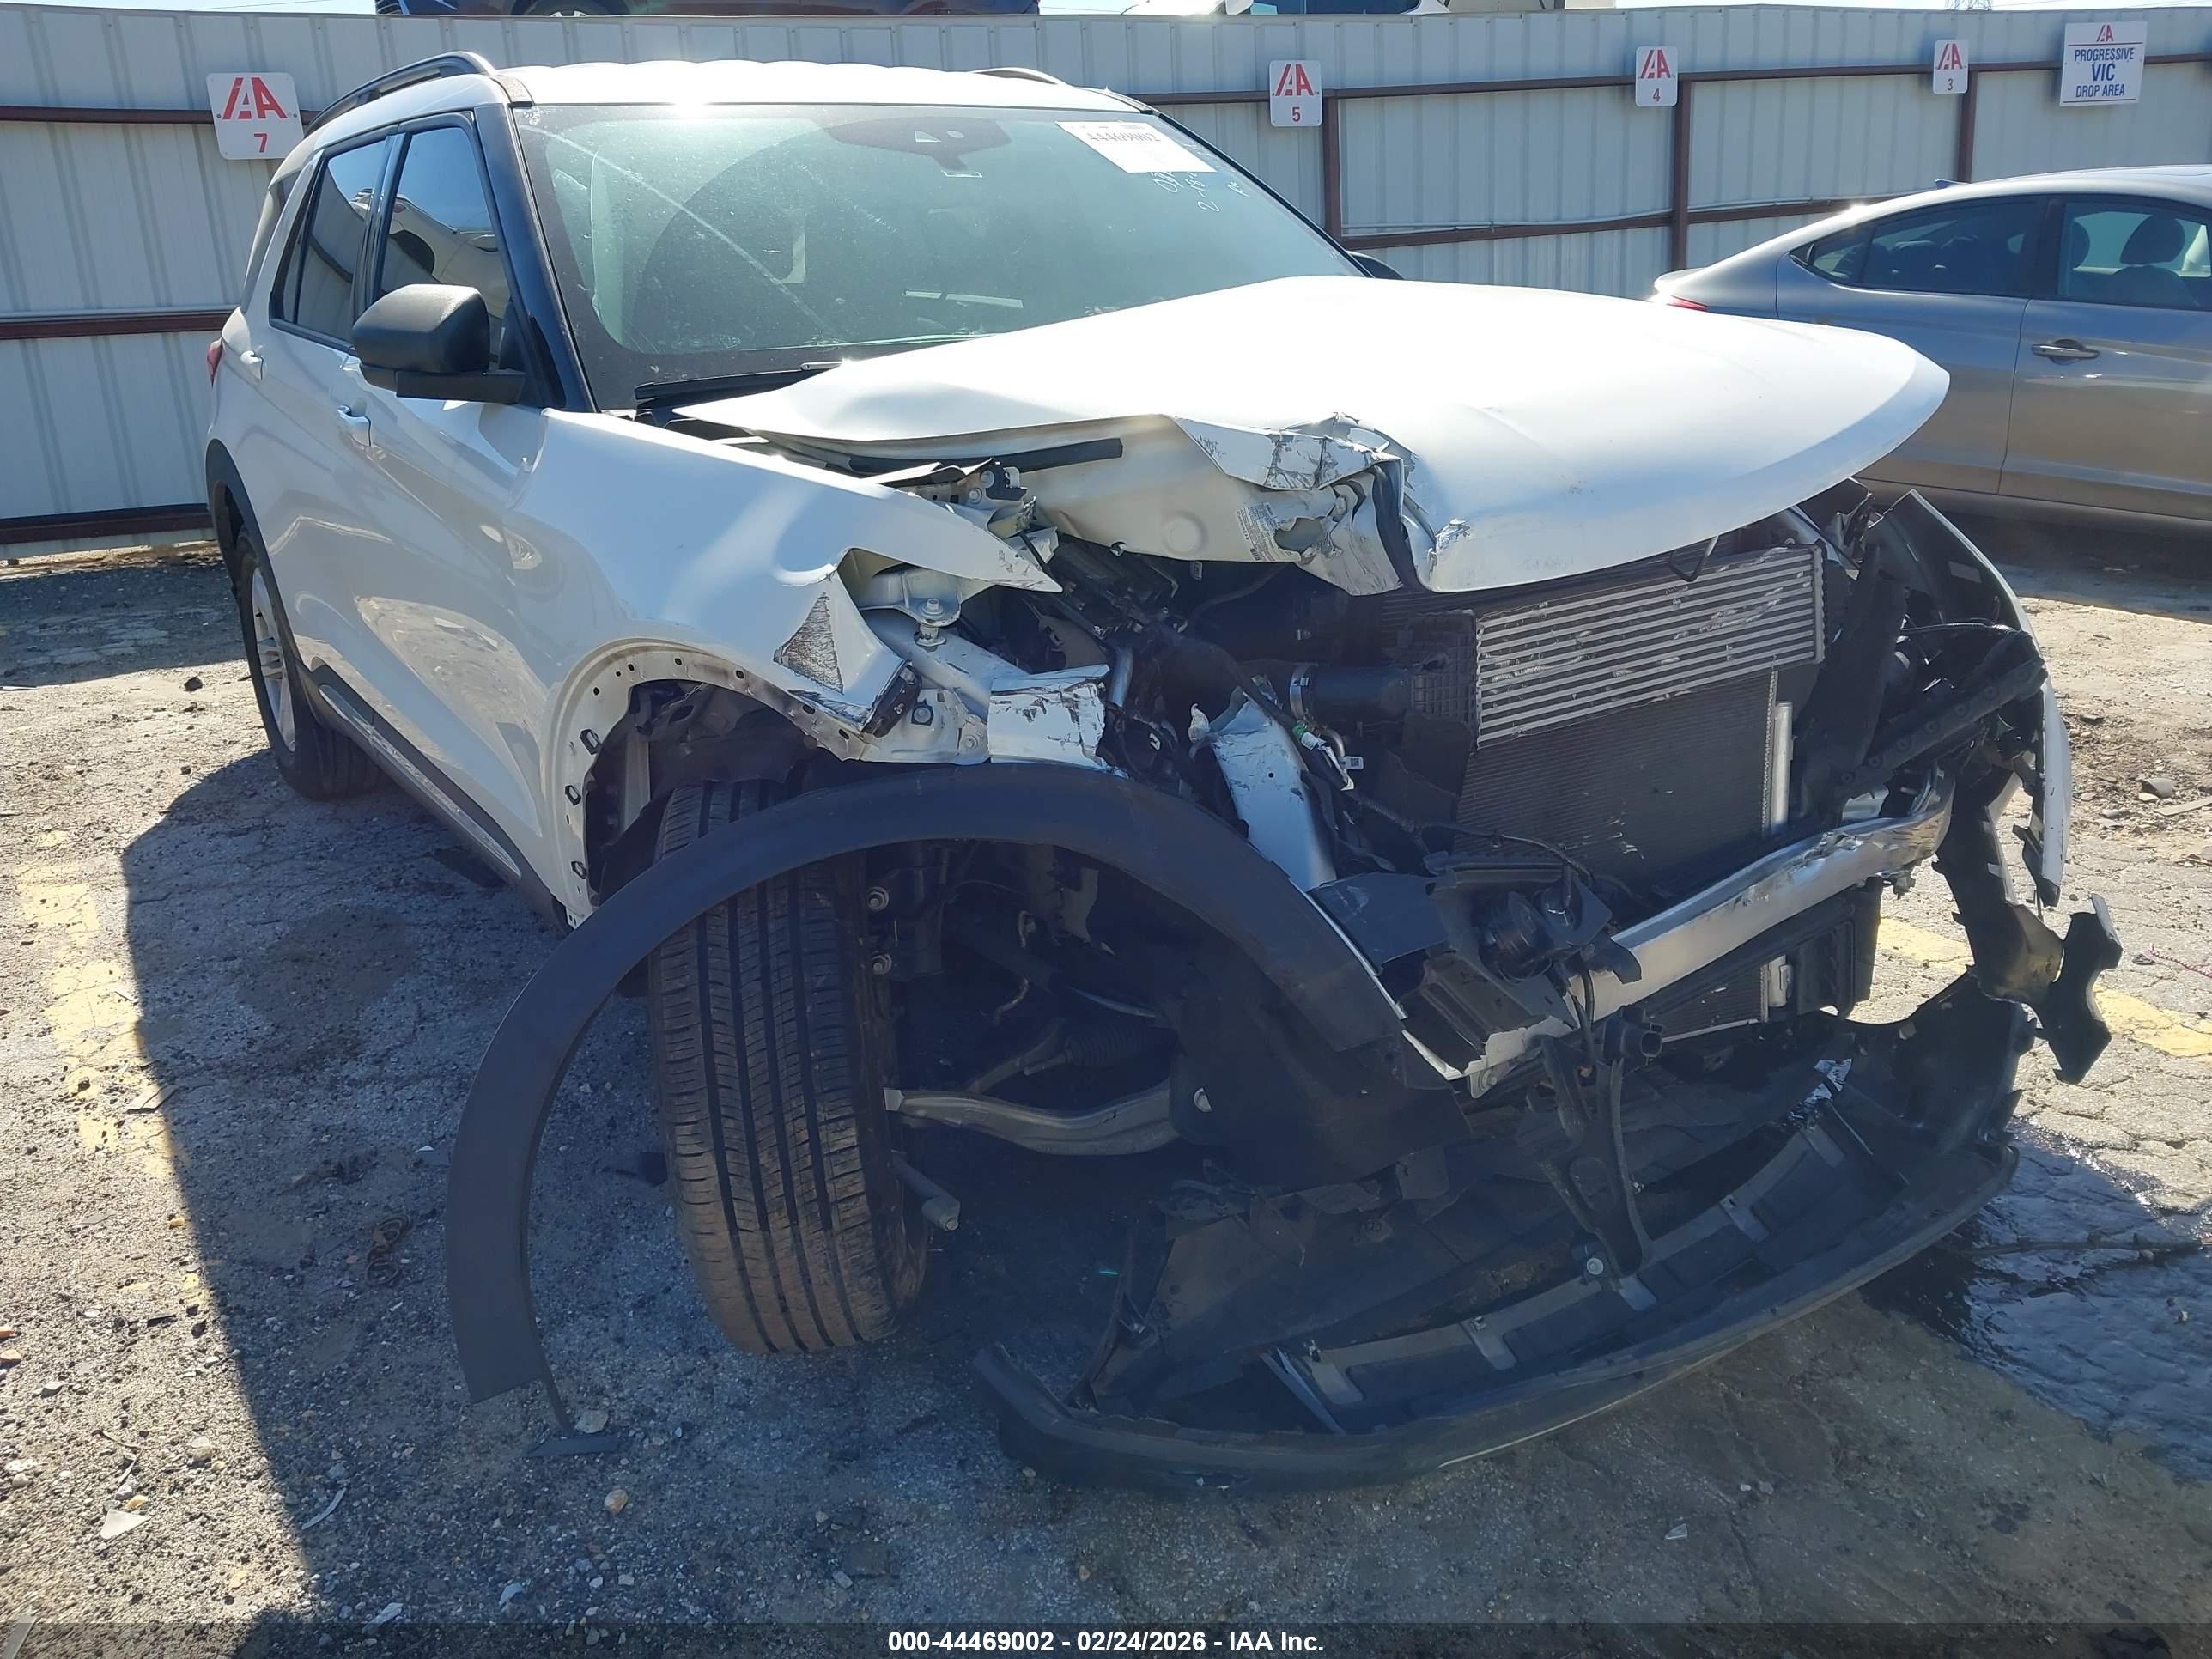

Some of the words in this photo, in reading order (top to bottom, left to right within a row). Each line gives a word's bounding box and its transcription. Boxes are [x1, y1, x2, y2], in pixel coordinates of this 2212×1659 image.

[2075, 47, 2135, 62] PROGRESSIVE
[2092, 63, 2115, 81] VIC
[1948, 78, 1954, 90] 3
[2075, 85, 2100, 97] DROP
[2101, 84, 2125, 96] AREA
[1653, 88, 1660, 102] 4
[1292, 106, 1301, 122] 5
[253, 133, 268, 153] 7
